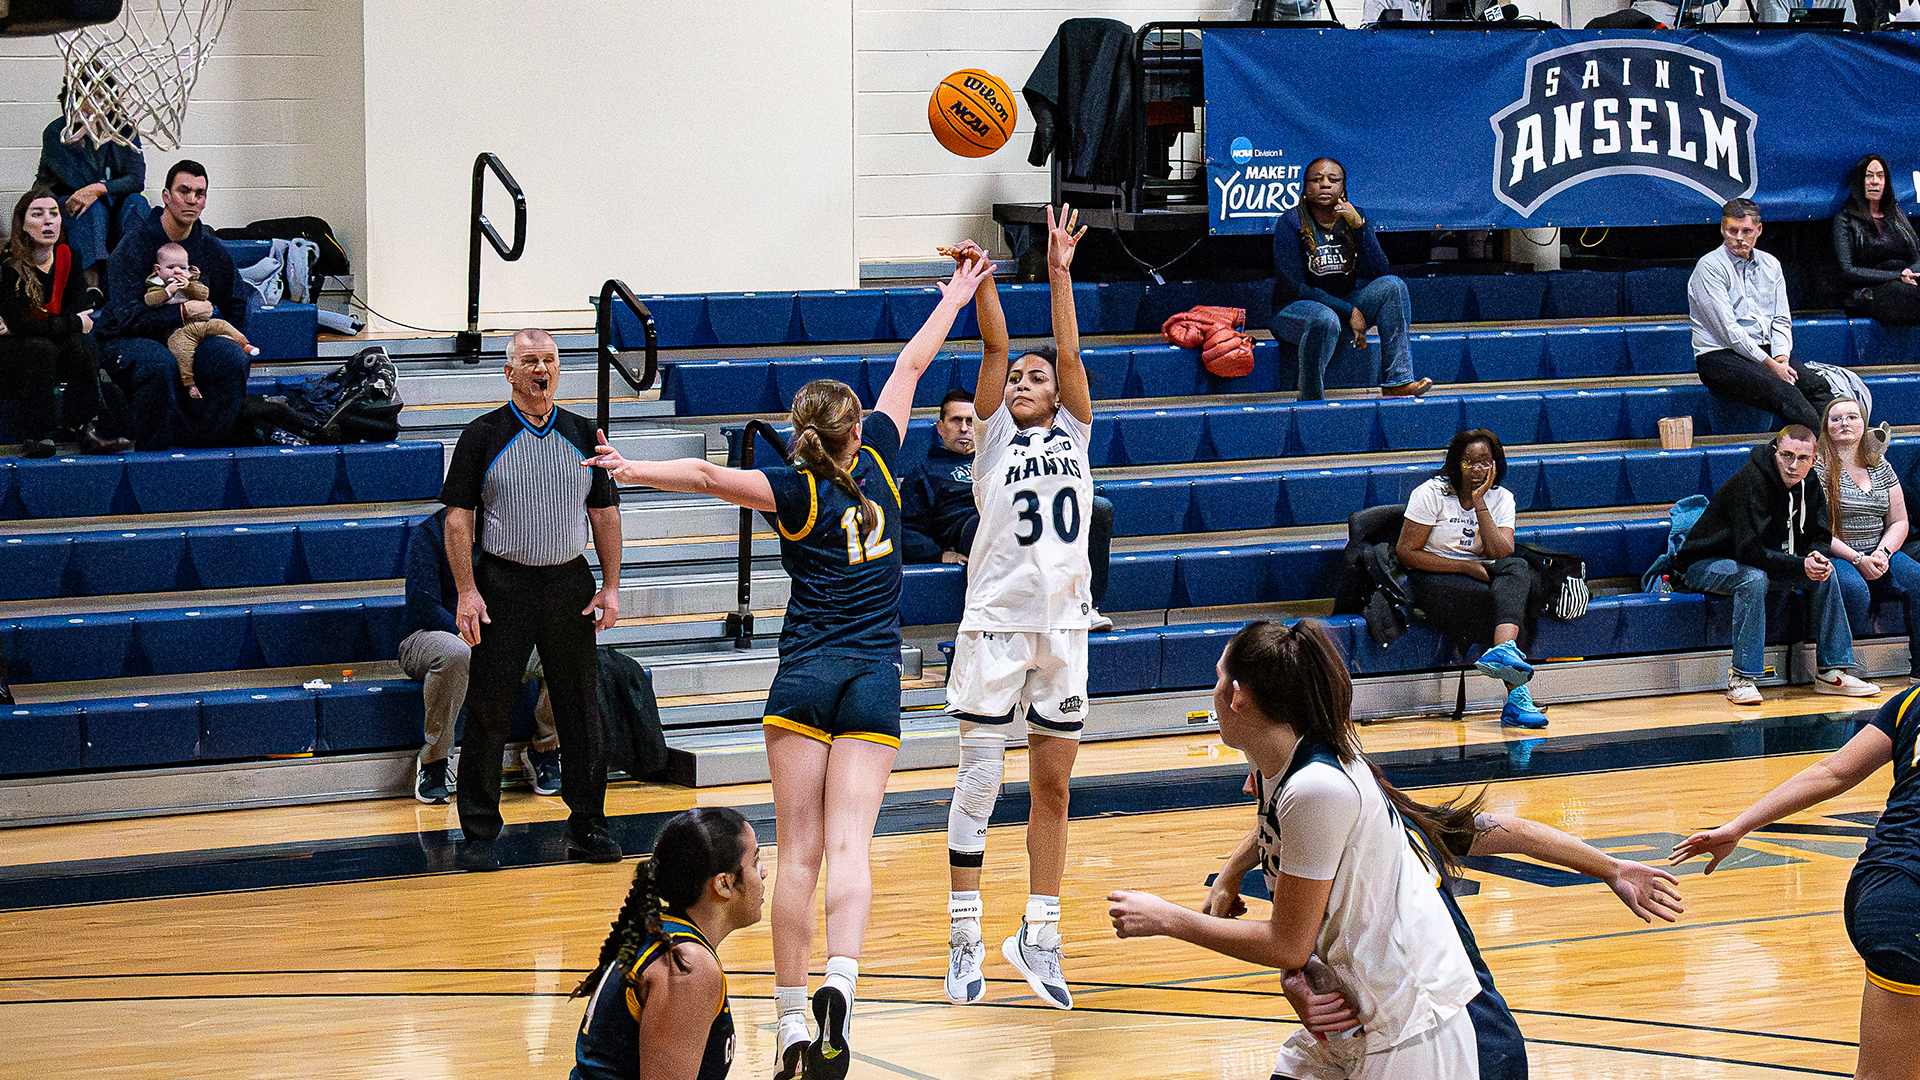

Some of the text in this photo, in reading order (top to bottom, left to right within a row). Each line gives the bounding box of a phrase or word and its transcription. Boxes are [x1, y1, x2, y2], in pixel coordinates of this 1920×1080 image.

[963, 75, 1009, 123] Wilson
[1545, 58, 1705, 97] SAINT
[949, 100, 991, 138] NCAA
[1254, 148, 1278, 158] Division
[1508, 97, 1744, 188] ANSELM
[1245, 166, 1302, 180] MAKE IT
[1213, 170, 1301, 221] YOURS
[1004, 455, 1082, 487] HAWKS
[841, 499, 894, 566] 12
[1012, 486, 1081, 547] 30
